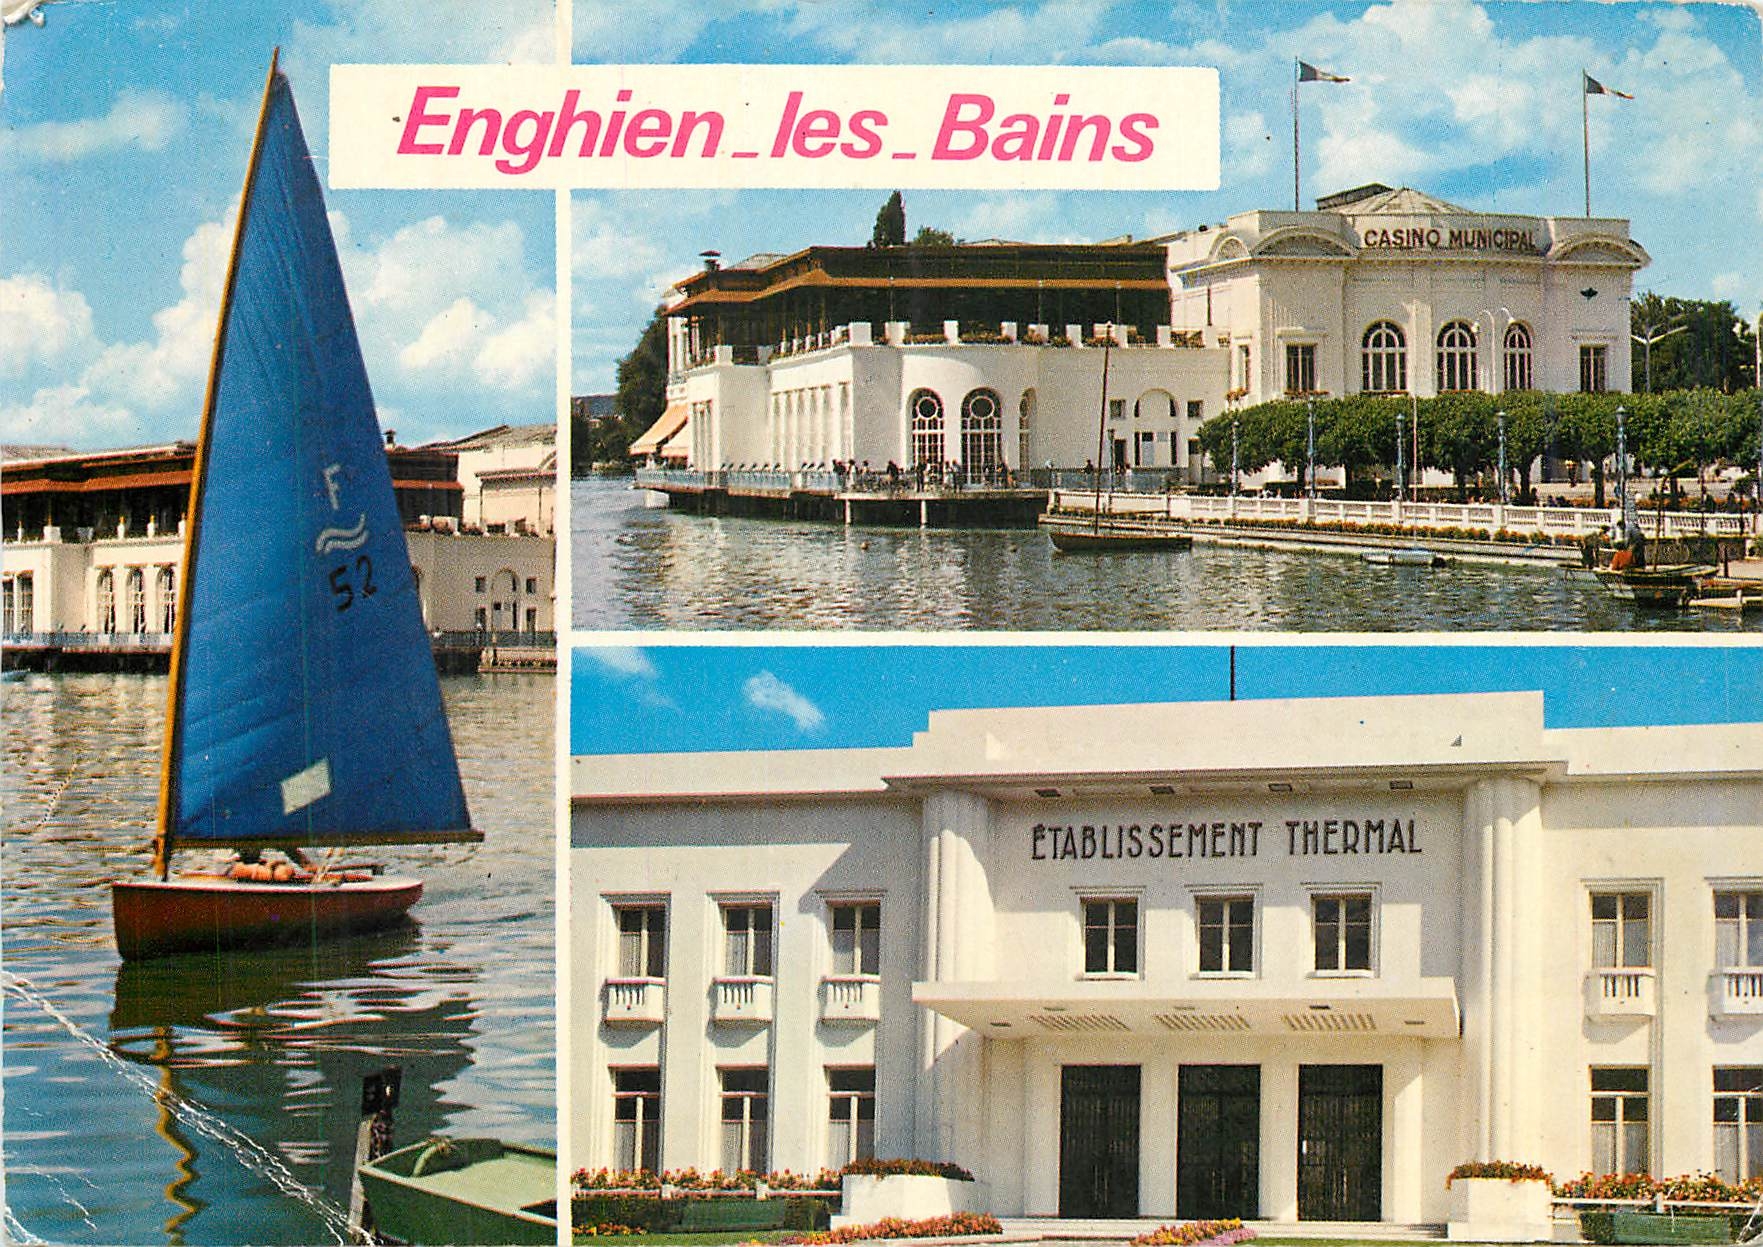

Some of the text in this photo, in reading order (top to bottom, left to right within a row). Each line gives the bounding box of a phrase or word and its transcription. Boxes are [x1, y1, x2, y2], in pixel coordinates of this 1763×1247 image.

[1364, 228, 1537, 250] CASINO MUNICIPAL
[323, 463, 341, 511] F
[329, 555, 377, 612] 52
[1286, 818, 1423, 856] THERMAL
